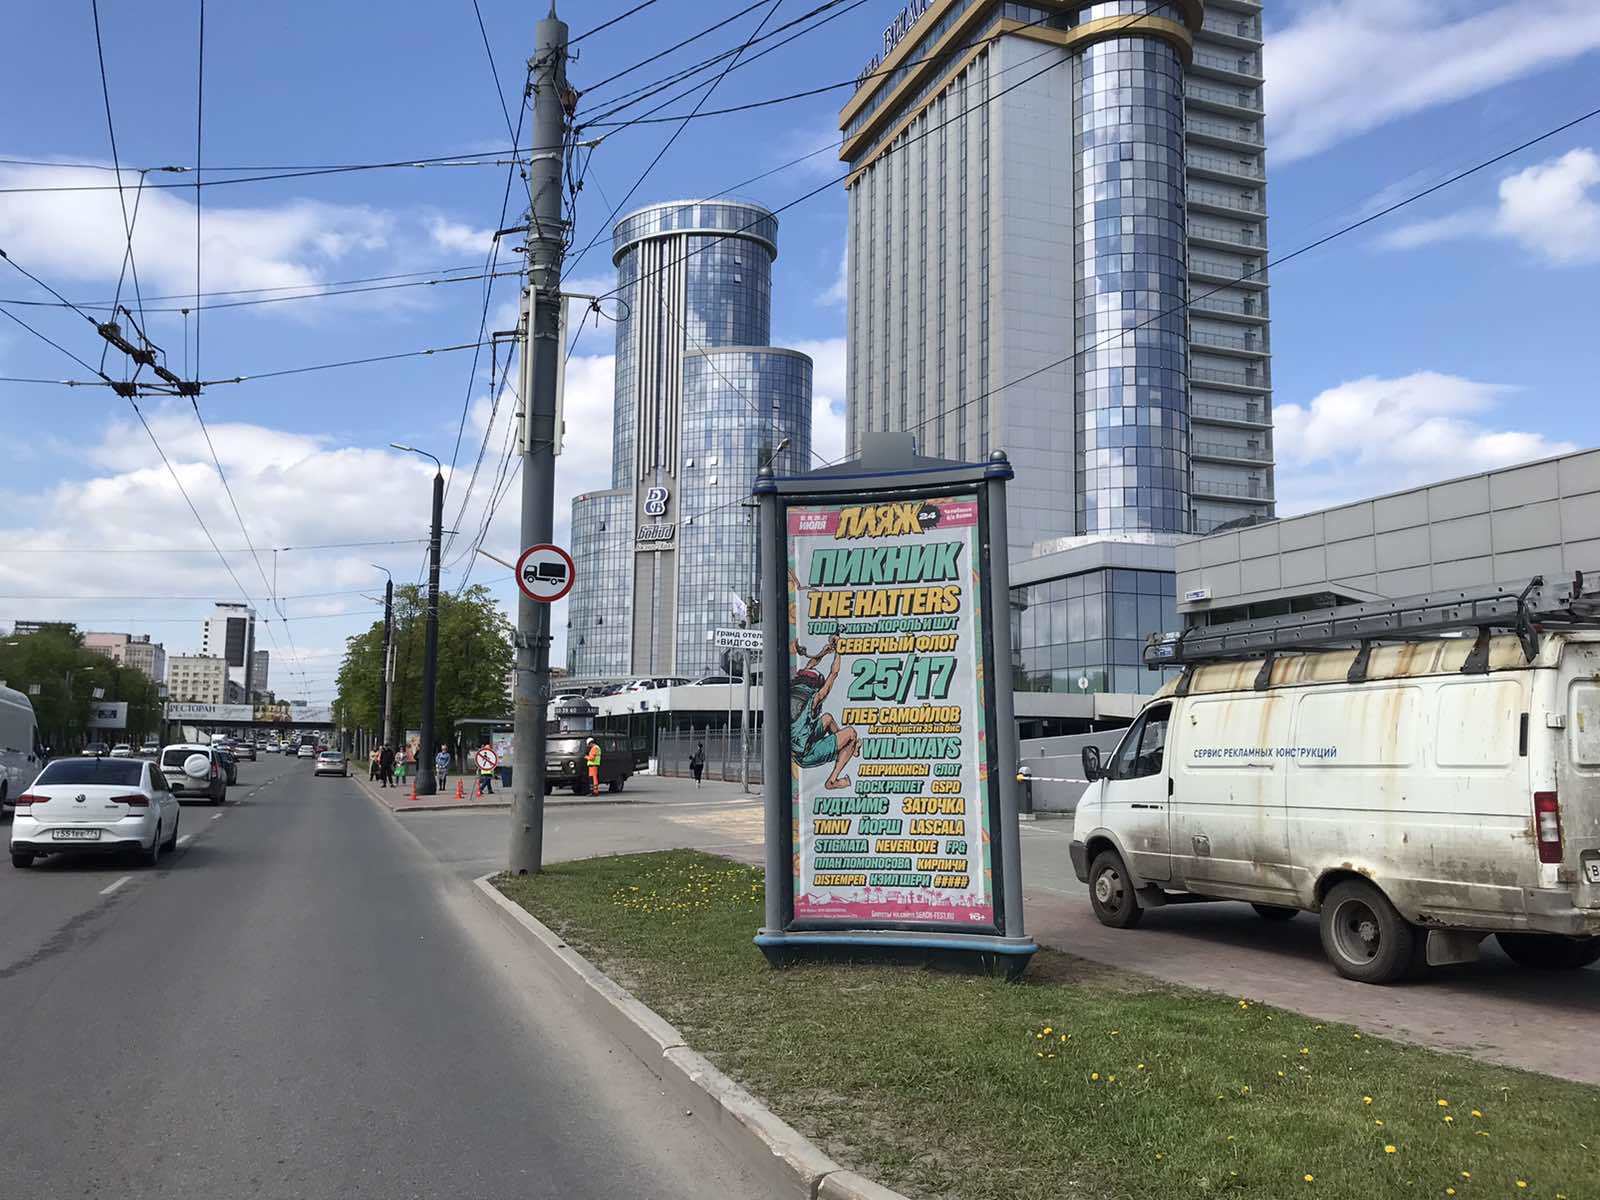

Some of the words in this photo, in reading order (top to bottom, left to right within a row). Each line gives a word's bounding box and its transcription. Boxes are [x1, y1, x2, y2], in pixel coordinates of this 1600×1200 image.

[834, 501, 925, 540] ПЛЯЖ
[919, 511, 937, 521] 24
[808, 541, 964, 587] ПИКНИК
[807, 590, 854, 619] THE
[854, 585, 962, 618] HATTERS
[877, 618, 921, 634] КОРОЛЬ
[933, 616, 960, 632] ШУТ
[836, 632, 915, 655] СЕВЕРНЫЙ
[916, 634, 960, 652] ФЛОТ
[847, 653, 958, 704] 25/17
[169, 704, 216, 712] РЕСТОРАН
[841, 707, 879, 726] ГЛЕБ
[879, 703, 962, 725] САМОЙЛОВ
[862, 736, 962, 760] WILDWAYS
[1193, 748, 1222, 758] СЕРВИС
[1223, 748, 1273, 758] РЕКЛАМНЫХ
[858, 763, 930, 777] ЛЕПРИКОНСЫ
[933, 763, 962, 777] СЛОТ
[930, 780, 962, 794] GSPD
[813, 794, 889, 816] ГУДТАЙМС
[902, 797, 966, 815] ЗАТОЧКА
[813, 818, 851, 836] TMNV
[857, 815, 903, 836] ЙОРШ
[909, 818, 966, 836] LASCALA
[814, 839, 869, 854] STIGMATA
[874, 839, 938, 854] NEVERLOVE
[945, 840, 967, 855] FPG
[814, 857, 843, 871] ПЛАН
[843, 857, 912, 871] ЛОМОНОСОВА
[916, 858, 968, 872] КИРПИЧИ
[813, 873, 866, 887] DISTEMPER
